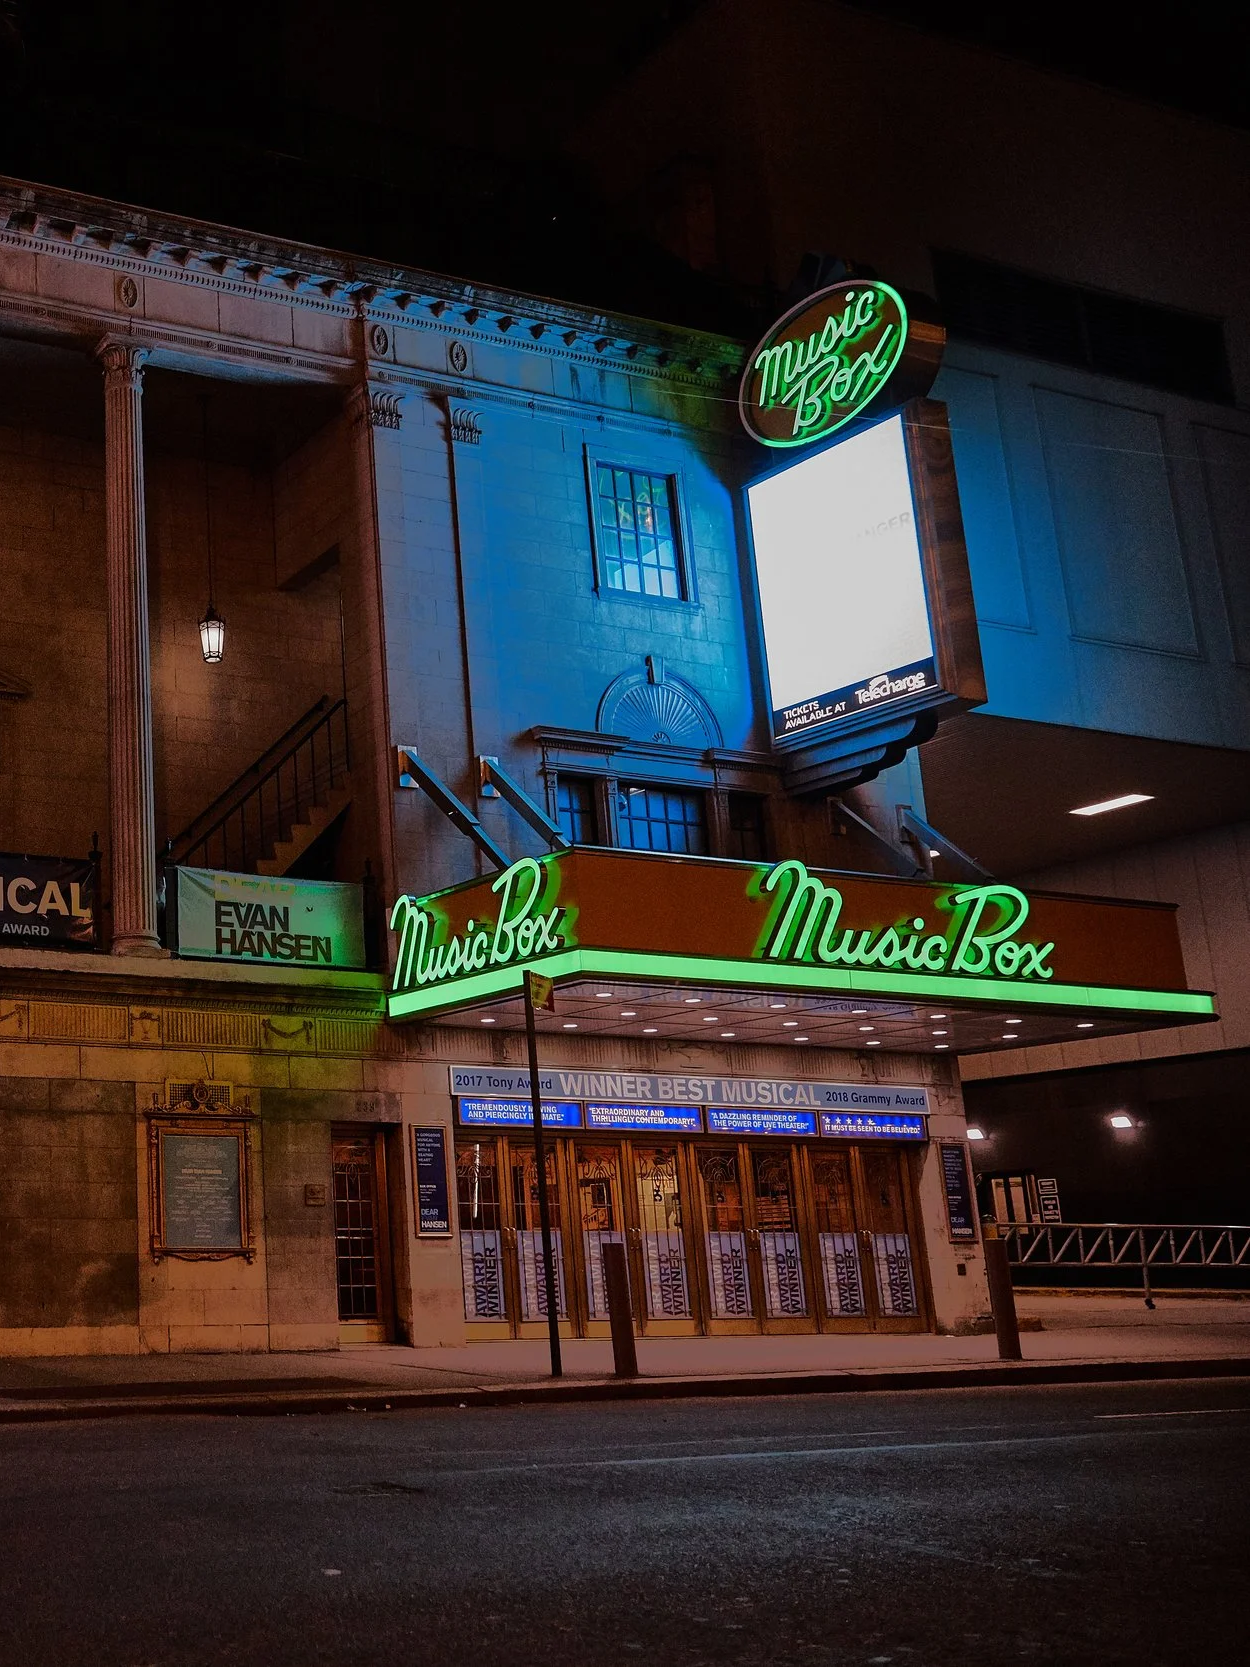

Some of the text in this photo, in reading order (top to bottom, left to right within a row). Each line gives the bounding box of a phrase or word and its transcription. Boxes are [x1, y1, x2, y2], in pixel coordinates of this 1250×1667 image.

[755, 290, 874, 407] Music
[781, 324, 893, 436] Box
[783, 700, 820, 720] TICKETS
[785, 702, 846, 730] AVAILABLE AT
[855, 672, 926, 704] Telecharge
[2, 923, 50, 937] AWARD
[215, 900, 290, 932] EVAN
[216, 928, 332, 963] HANSEN
[390, 856, 559, 990] Music Box
[764, 859, 1055, 978] Music Box
[455, 1073, 925, 1107] 2017 Tony Awrd WINNER BEST MUSICAL 2018 Grammy Award
[485, 1112, 527, 1120] PIERCINGLY
[528, 1105, 557, 1113] MVING
[591, 1115, 635, 1123] THRILLINGLY
[650, 1109, 665, 1117] AND
[421, 1208, 439, 1216] DEAR
[421, 1220, 448, 1229] HANSEN
[474, 1251, 487, 1317] AWARD
[485, 1247, 499, 1317] WINNER
[659, 1253, 673, 1316] AWARD
[669, 1248, 684, 1316] WINNER
[721, 1253, 736, 1314] AWARD
[731, 1248, 746, 1314] WINNER
[776, 1253, 790, 1314] AWARD
[785, 1248, 801, 1314] WINNER
[835, 1253, 849, 1313] AWARD
[844, 1248, 860, 1313] WINNER
[888, 1254, 902, 1313] AWARD
[896, 1249, 911, 1313] WINNER
